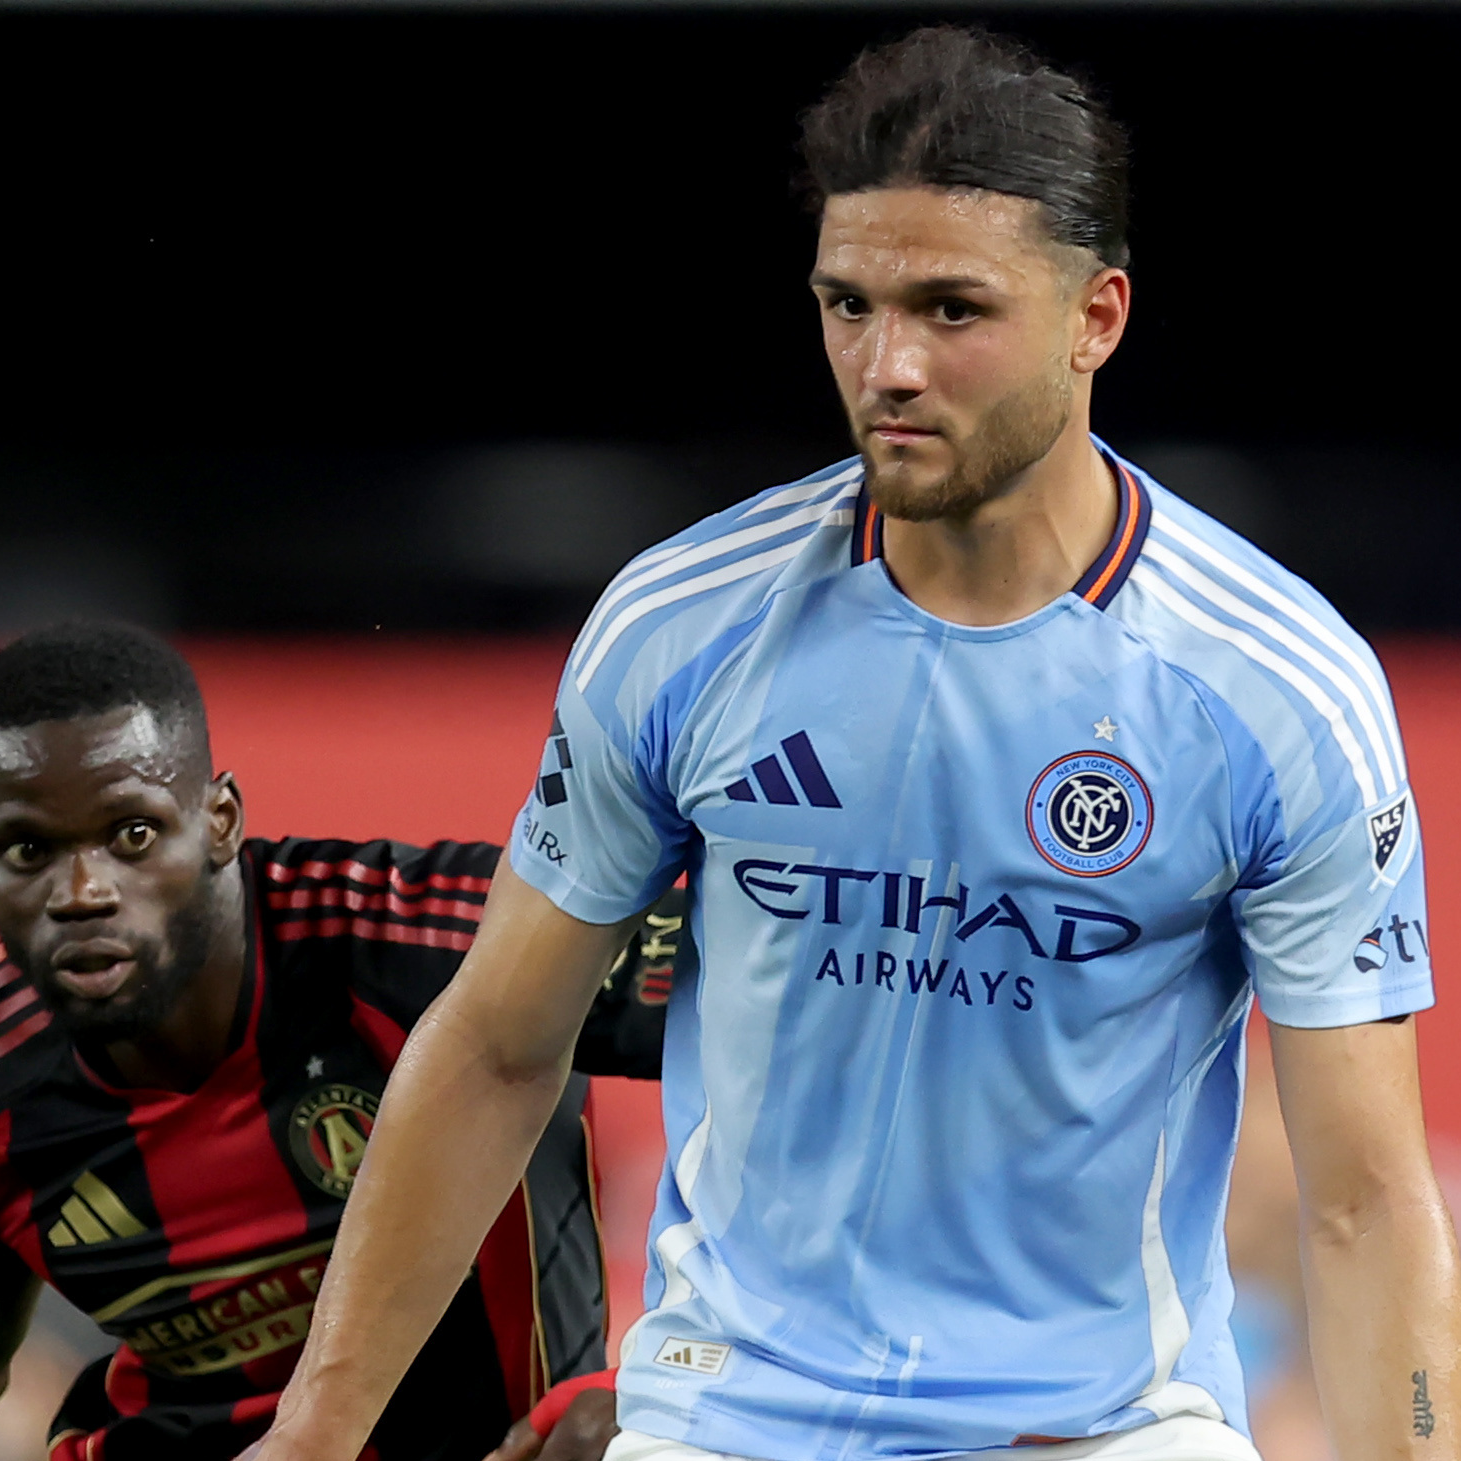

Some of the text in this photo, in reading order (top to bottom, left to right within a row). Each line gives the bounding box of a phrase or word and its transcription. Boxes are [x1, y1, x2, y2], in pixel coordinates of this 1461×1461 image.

[1055, 759, 1137, 790] NEW YORK CITY
[1372, 806, 1403, 838] MLS
[537, 830, 569, 868] Rx
[1042, 836, 1126, 869] FOOTBALL CLUB
[733, 858, 1142, 963] ETIHAD
[815, 947, 1036, 1013] AIRWAYS
[127, 1276, 289, 1352] MERICAN
